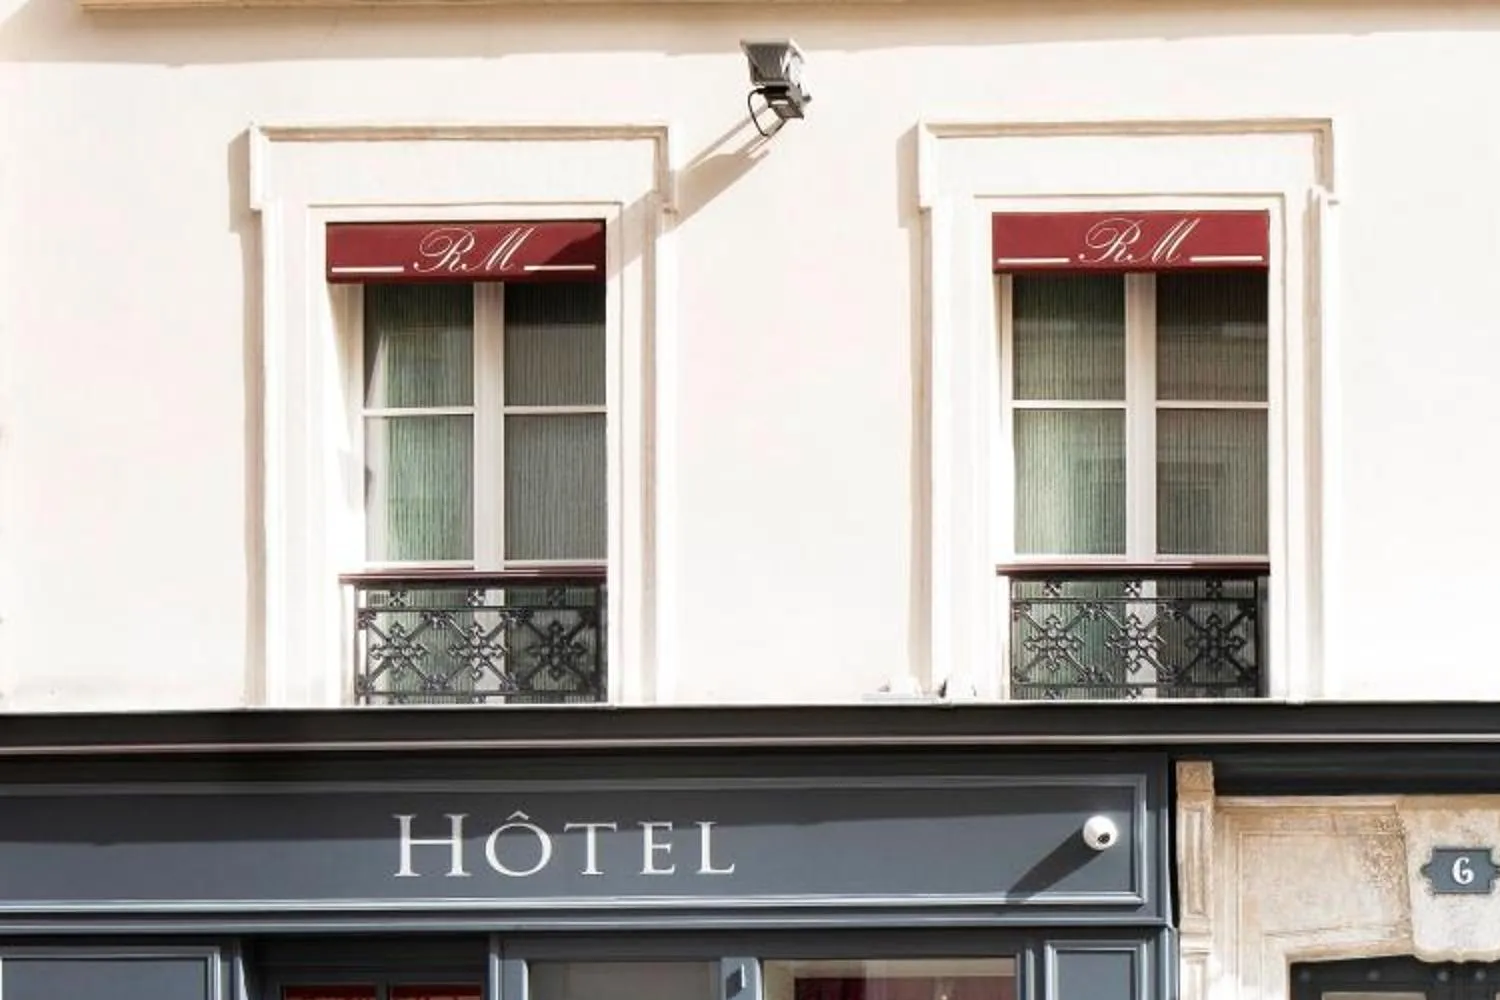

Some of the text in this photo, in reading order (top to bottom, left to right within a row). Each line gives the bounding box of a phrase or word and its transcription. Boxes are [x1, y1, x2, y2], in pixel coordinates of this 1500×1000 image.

[413, 224, 541, 273] RM
[1078, 217, 1200, 264] RM
[392, 810, 736, 878] HÔTEL
[1452, 856, 1475, 885] 6
